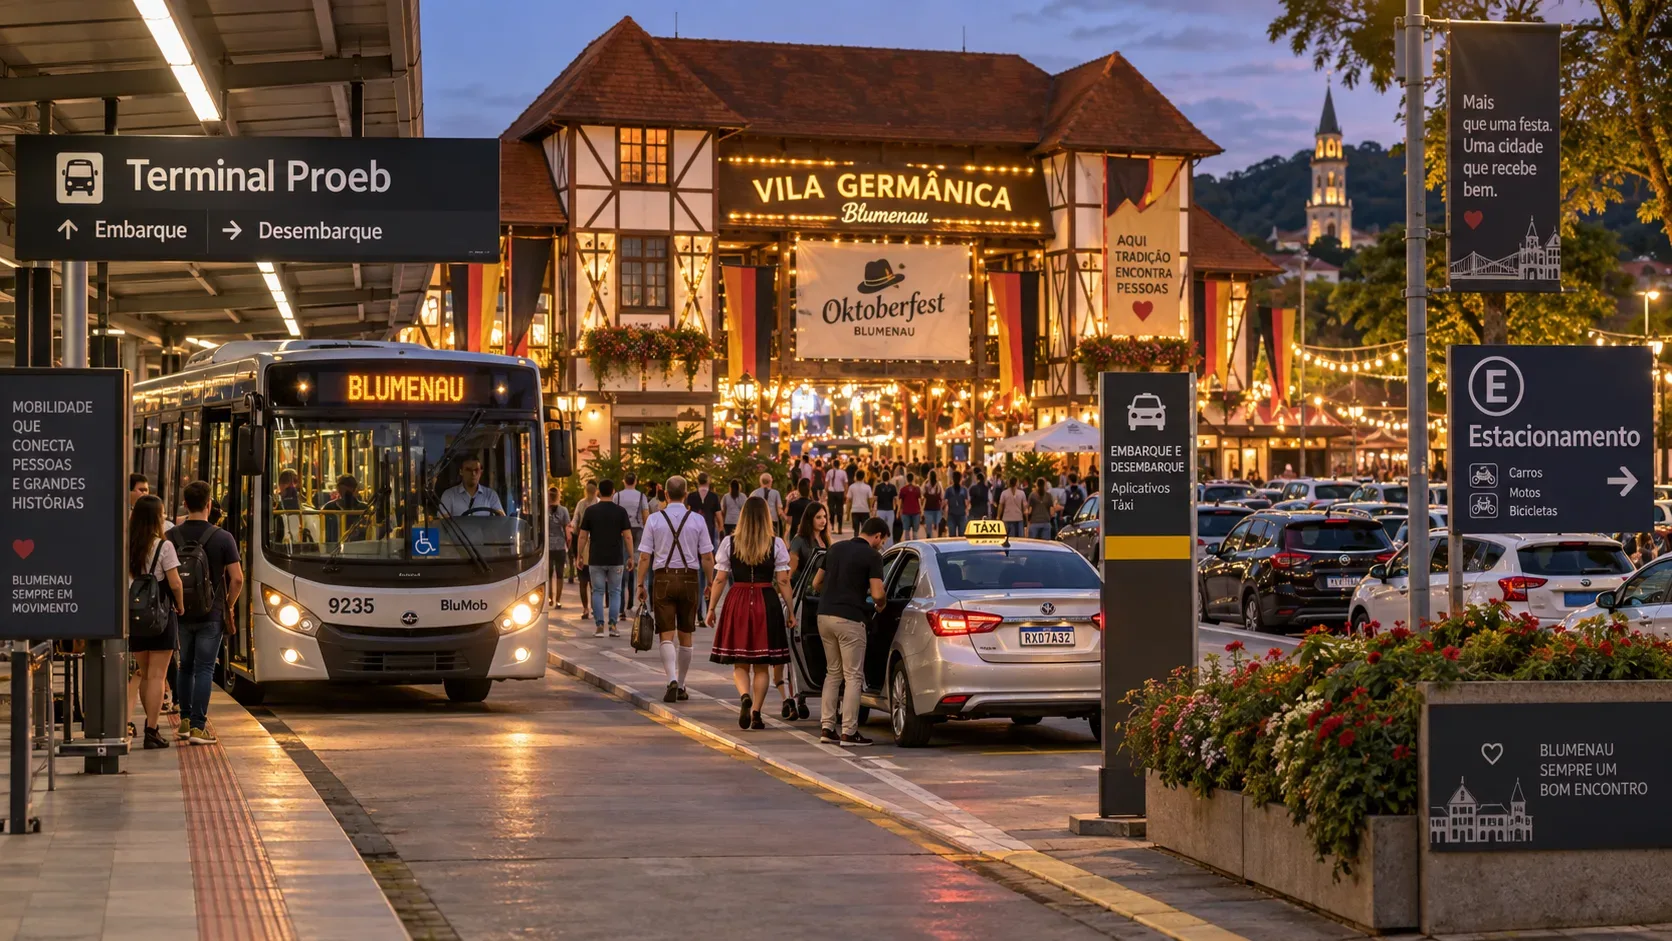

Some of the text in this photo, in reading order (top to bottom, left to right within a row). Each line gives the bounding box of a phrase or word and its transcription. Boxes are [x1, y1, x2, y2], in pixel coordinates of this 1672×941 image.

[1463, 93, 1495, 110] Mais
[1462, 115, 1553, 134] que uma festa.
[1463, 137, 1544, 154] Uma cidade
[127, 159, 390, 192] Terminal Proeb
[1463, 159, 1537, 179] que recebe
[753, 170, 1012, 212] VILA GERMÂNICA
[1463, 181, 1498, 197] bem.
[841, 202, 929, 225] Blumenau
[96, 220, 187, 242] Embarque
[260, 222, 382, 243] Desembarque
[1116, 234, 1147, 248] AQUI
[1114, 249, 1171, 265] TRADIÇÃO
[1115, 266, 1173, 279] ENCONTRA
[1116, 282, 1169, 295] PESSOAS
[822, 290, 946, 325] Oktoberfest
[853, 325, 915, 337] BLUMENAU
[349, 376, 463, 401] BLUMENAU
[1487, 370, 1507, 402] E
[12, 400, 93, 414] MOBILIDADE
[12, 419, 41, 435] QUE
[1470, 424, 1640, 447] Estacionamento
[12, 438, 75, 452] CONECTA
[1110, 445, 1182, 458] EMBARQUE E
[12, 458, 72, 471] PESSOAS
[1110, 461, 1185, 474] DESEMBARQUE
[1508, 466, 1543, 479] Carros
[12, 477, 86, 490] E GRANDES
[1110, 481, 1171, 497] Aplicativos
[1509, 487, 1541, 498] Motos
[12, 493, 84, 510] HISTÓRIAS
[1111, 498, 1134, 511] Táxi
[1509, 505, 1558, 517] Bicicletas
[12, 574, 72, 586] BLUMENAU
[12, 588, 73, 600] SEMPRE EM
[12, 602, 79, 614] MOVIMENTO
[329, 598, 374, 614] 9235
[440, 598, 488, 611] BluMob
[1540, 742, 1614, 757] BLUMENAU
[1539, 762, 1617, 777] SEMPRE UM
[1540, 781, 1648, 797] BOM ENCONTRO
